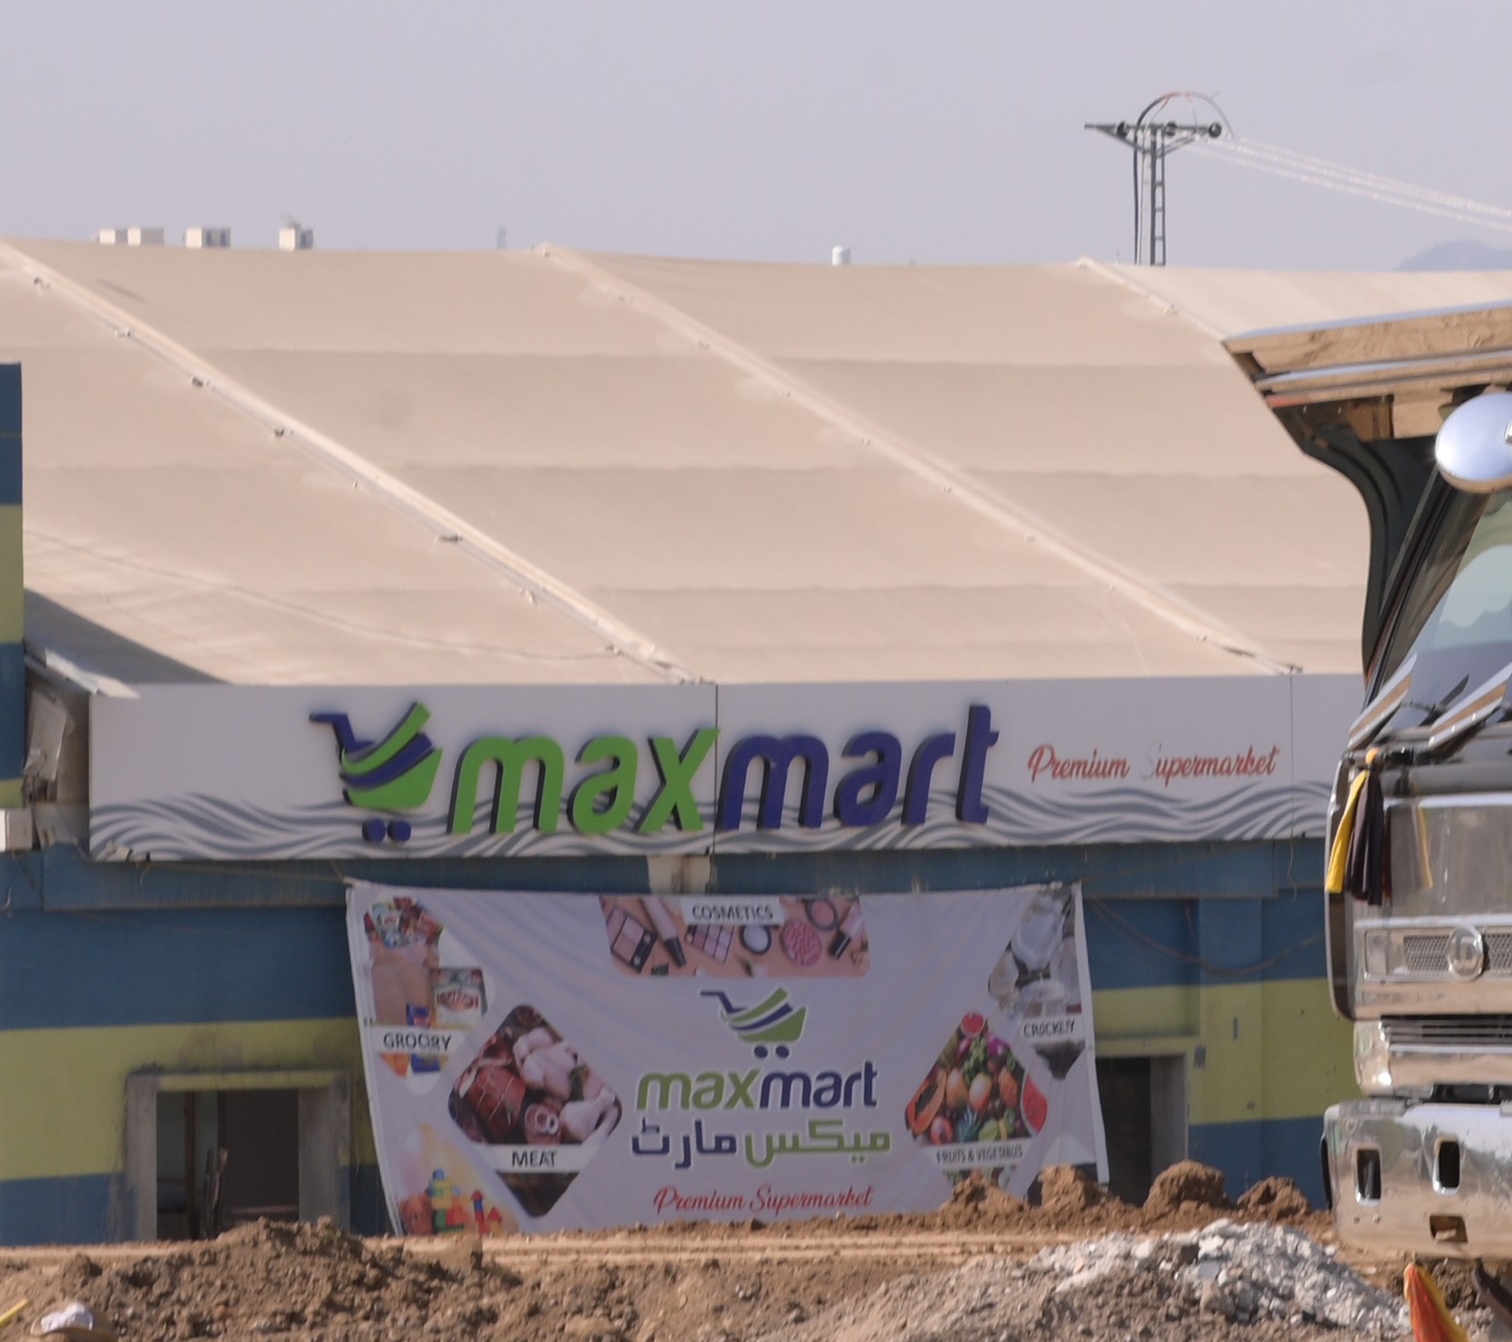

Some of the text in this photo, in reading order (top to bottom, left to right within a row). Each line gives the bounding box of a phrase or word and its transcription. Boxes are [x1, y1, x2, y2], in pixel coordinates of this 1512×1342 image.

[1027, 743, 1131, 783] Premium
[692, 905, 774, 920] COSMETICS
[511, 1148, 559, 1168] MEAT
[653, 1184, 874, 1216] Premium Supermarket
